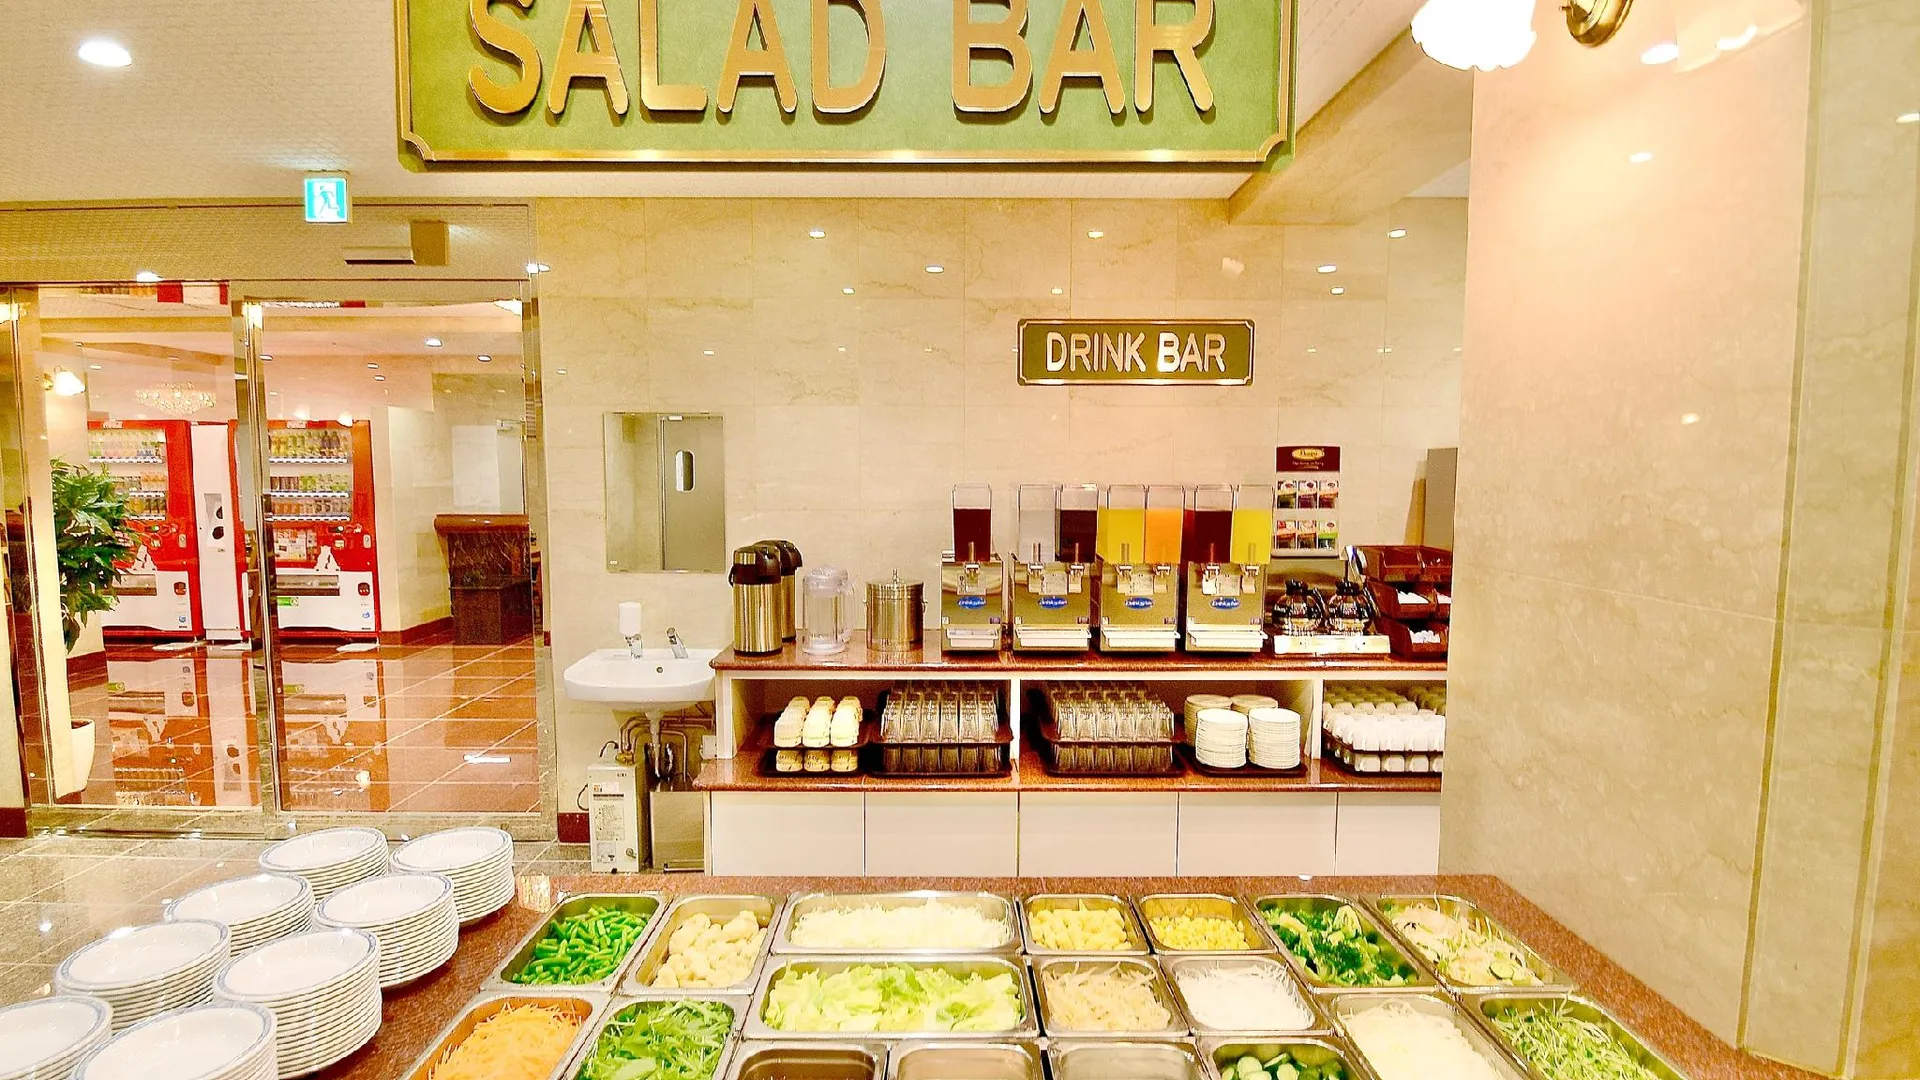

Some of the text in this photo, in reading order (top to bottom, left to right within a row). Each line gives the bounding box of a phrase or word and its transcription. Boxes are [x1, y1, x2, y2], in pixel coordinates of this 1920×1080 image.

[468, 0, 1214, 115] SALAD BAR
[1046, 331, 1226, 373] DRINK BAR
